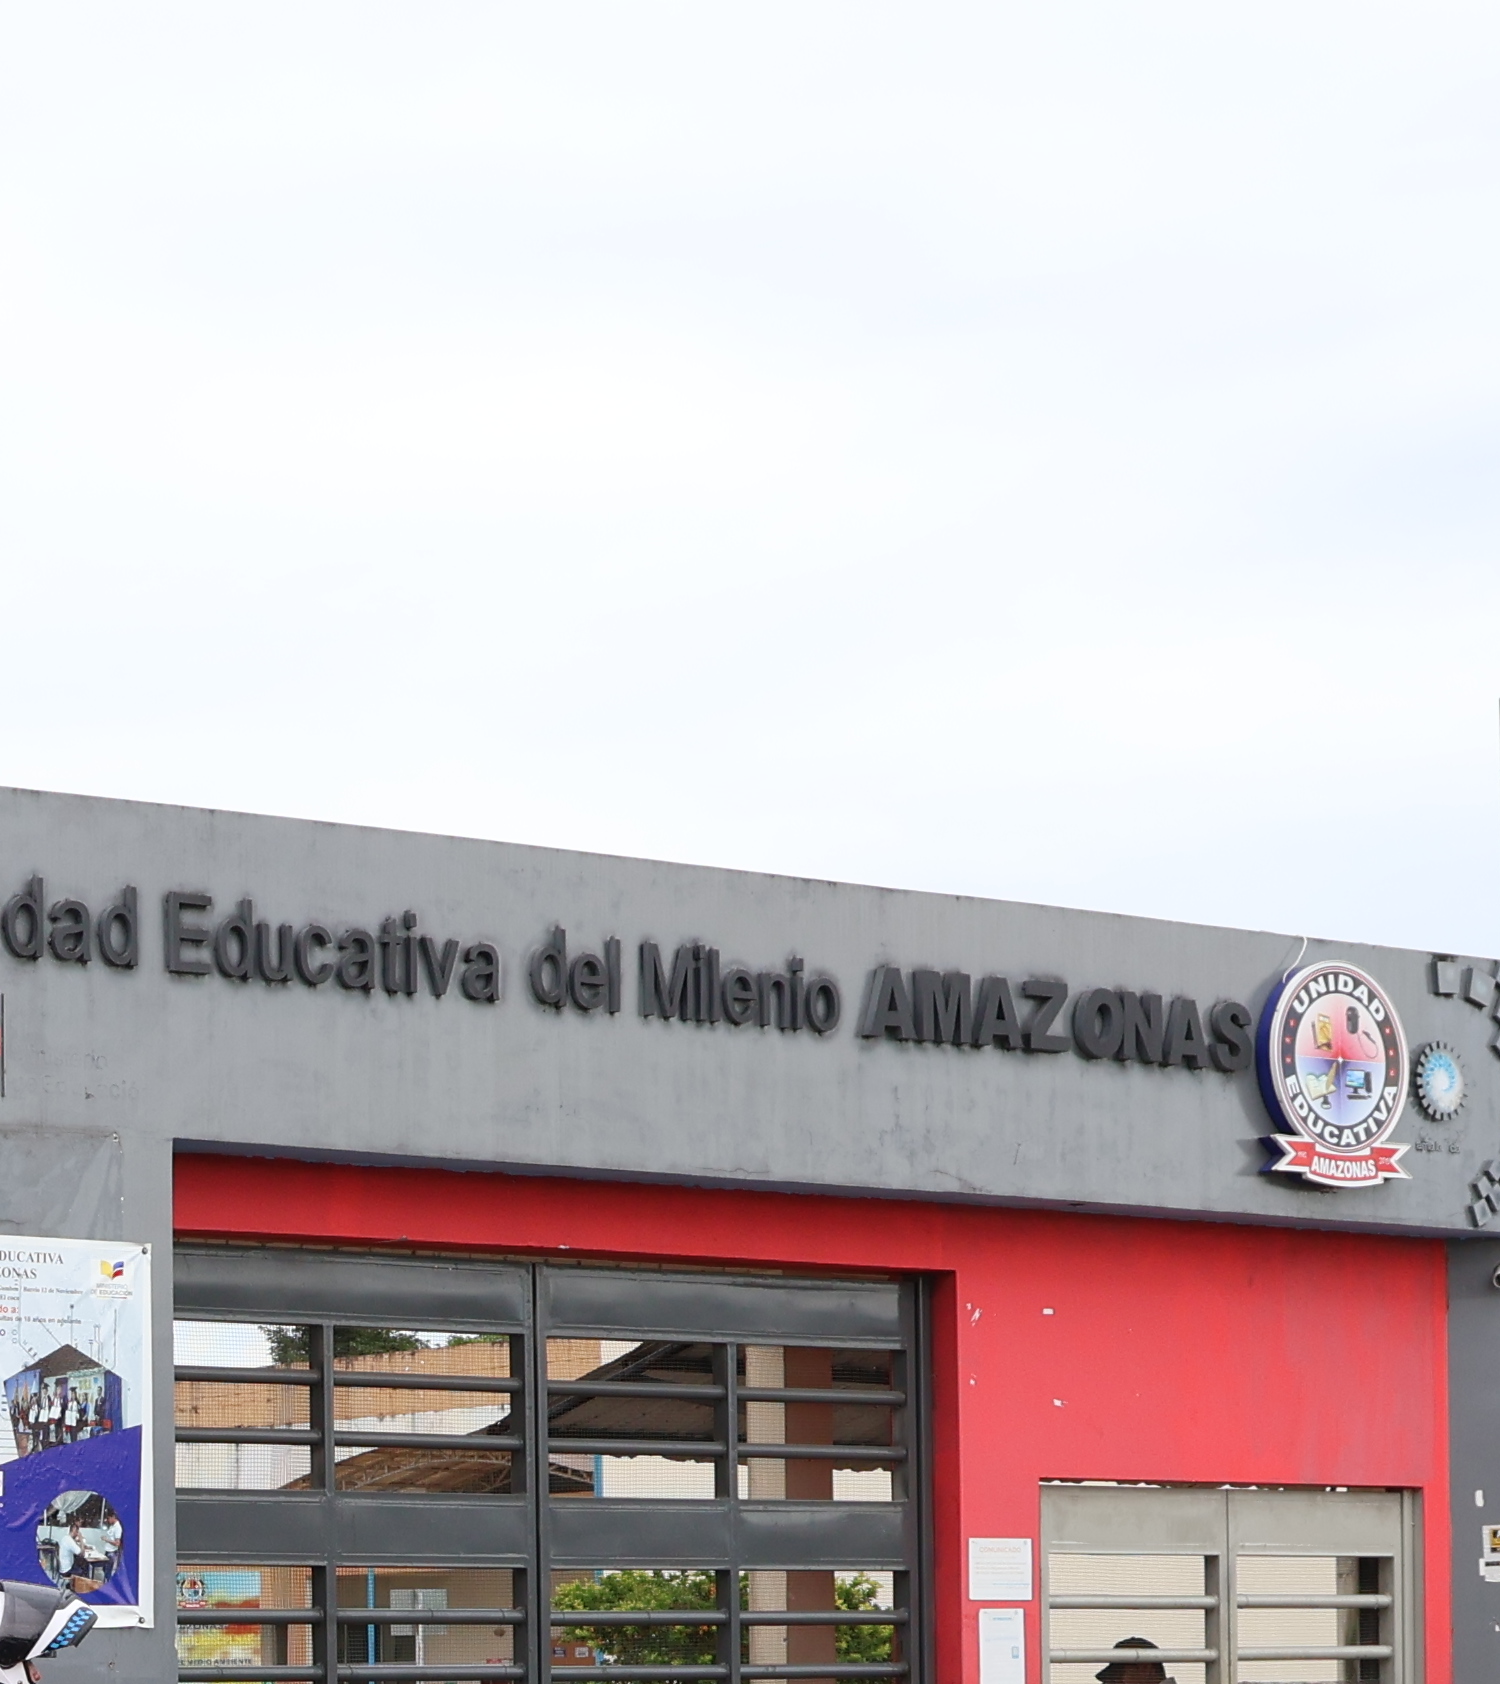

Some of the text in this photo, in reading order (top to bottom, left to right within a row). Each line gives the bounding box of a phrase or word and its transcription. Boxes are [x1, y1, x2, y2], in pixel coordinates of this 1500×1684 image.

[164, 889, 501, 1004] Educativa
[529, 923, 621, 1015] del
[638, 940, 840, 1036] Milenio
[858, 963, 1253, 1074] AMAZONAS
[1292, 973, 1386, 1023] UNIDAD
[1284, 1073, 1399, 1146] EDUCATIVA
[1311, 1155, 1377, 1178] AMAZONAS
[99, 1288, 133, 1296] EDUCACIÓN
[11, 1306, 19, 1314] a:
[213, 1658, 252, 1666] AMBIENTE
